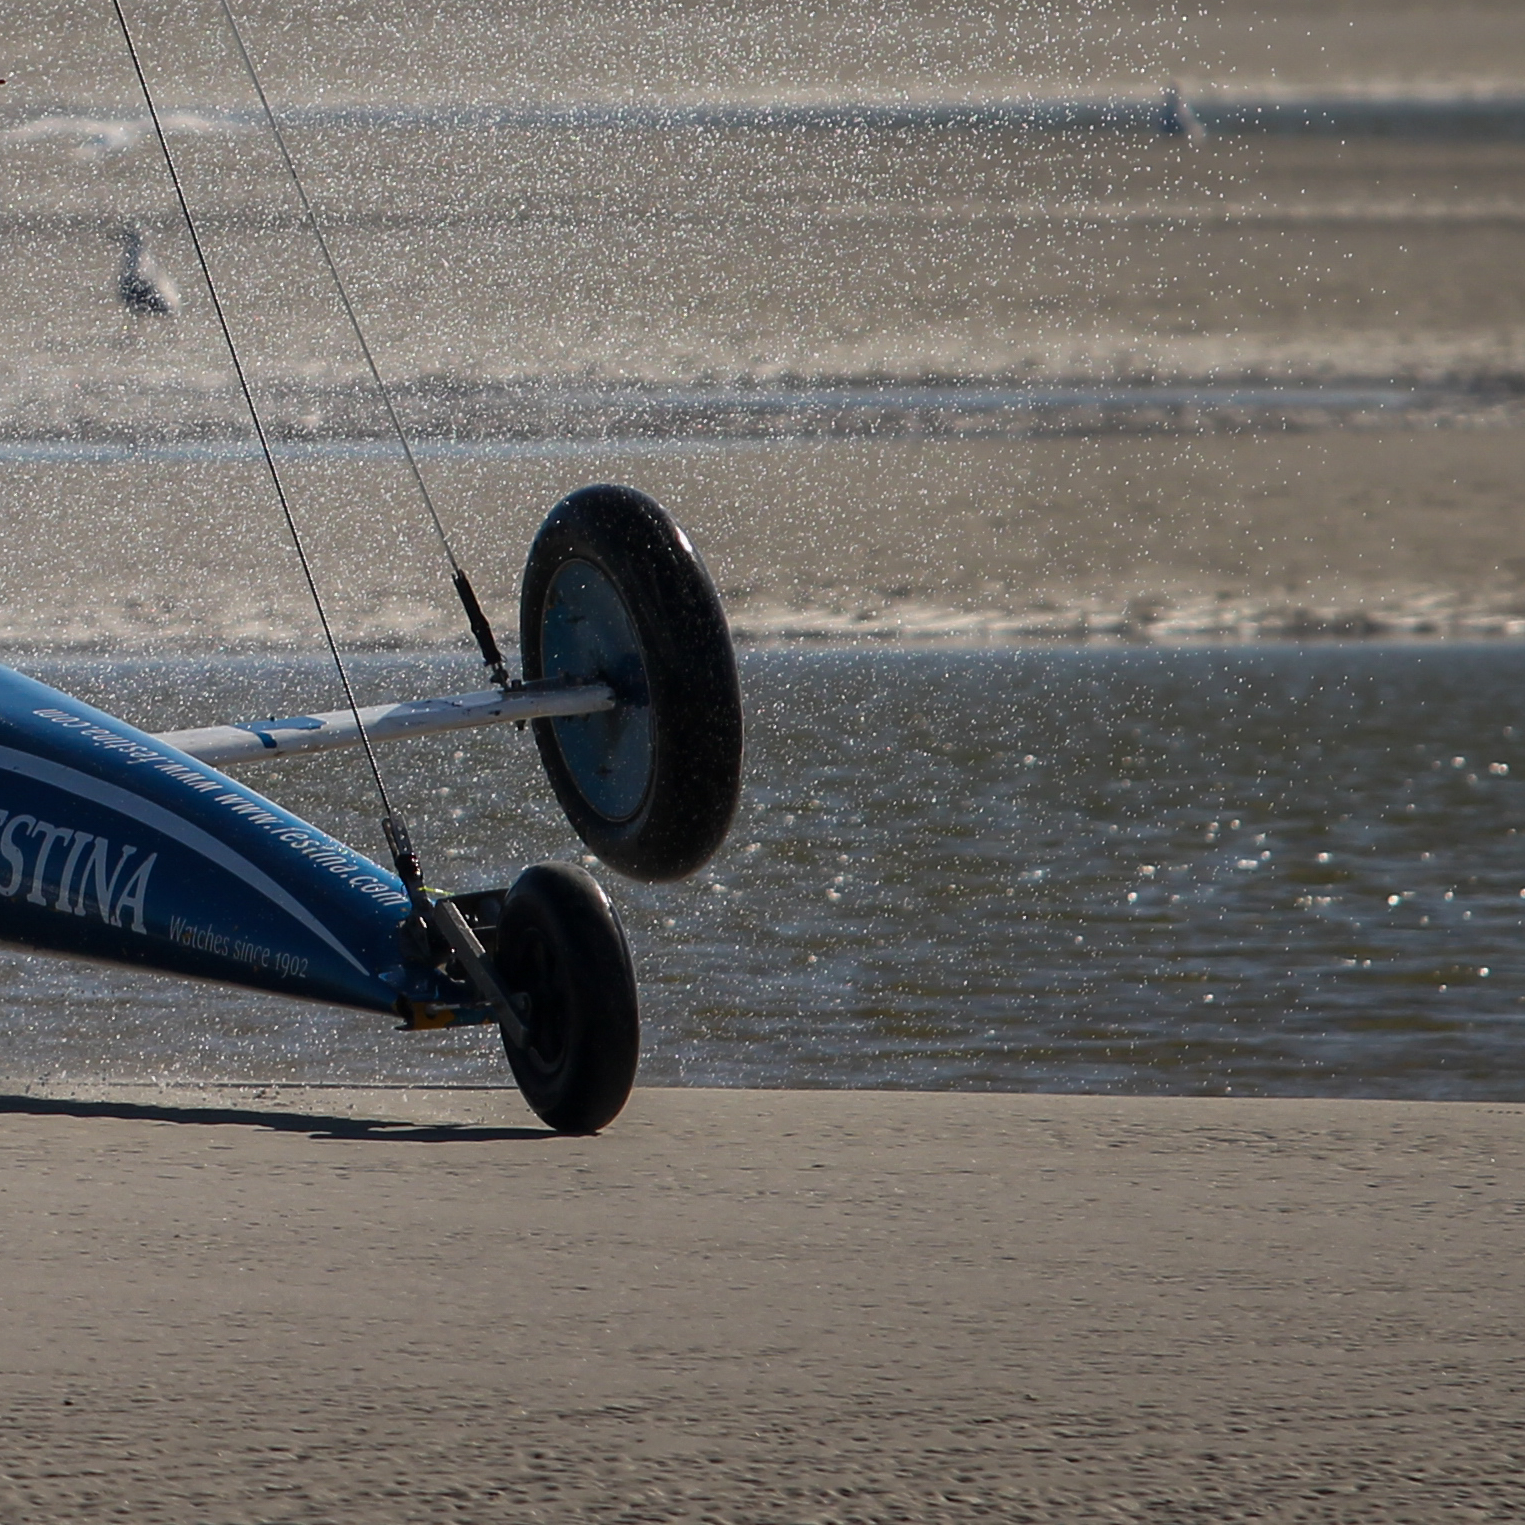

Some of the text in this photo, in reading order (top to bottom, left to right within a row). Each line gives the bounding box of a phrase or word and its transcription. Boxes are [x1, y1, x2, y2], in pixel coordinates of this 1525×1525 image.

[169, 915, 309, 978] Watches since 1902
